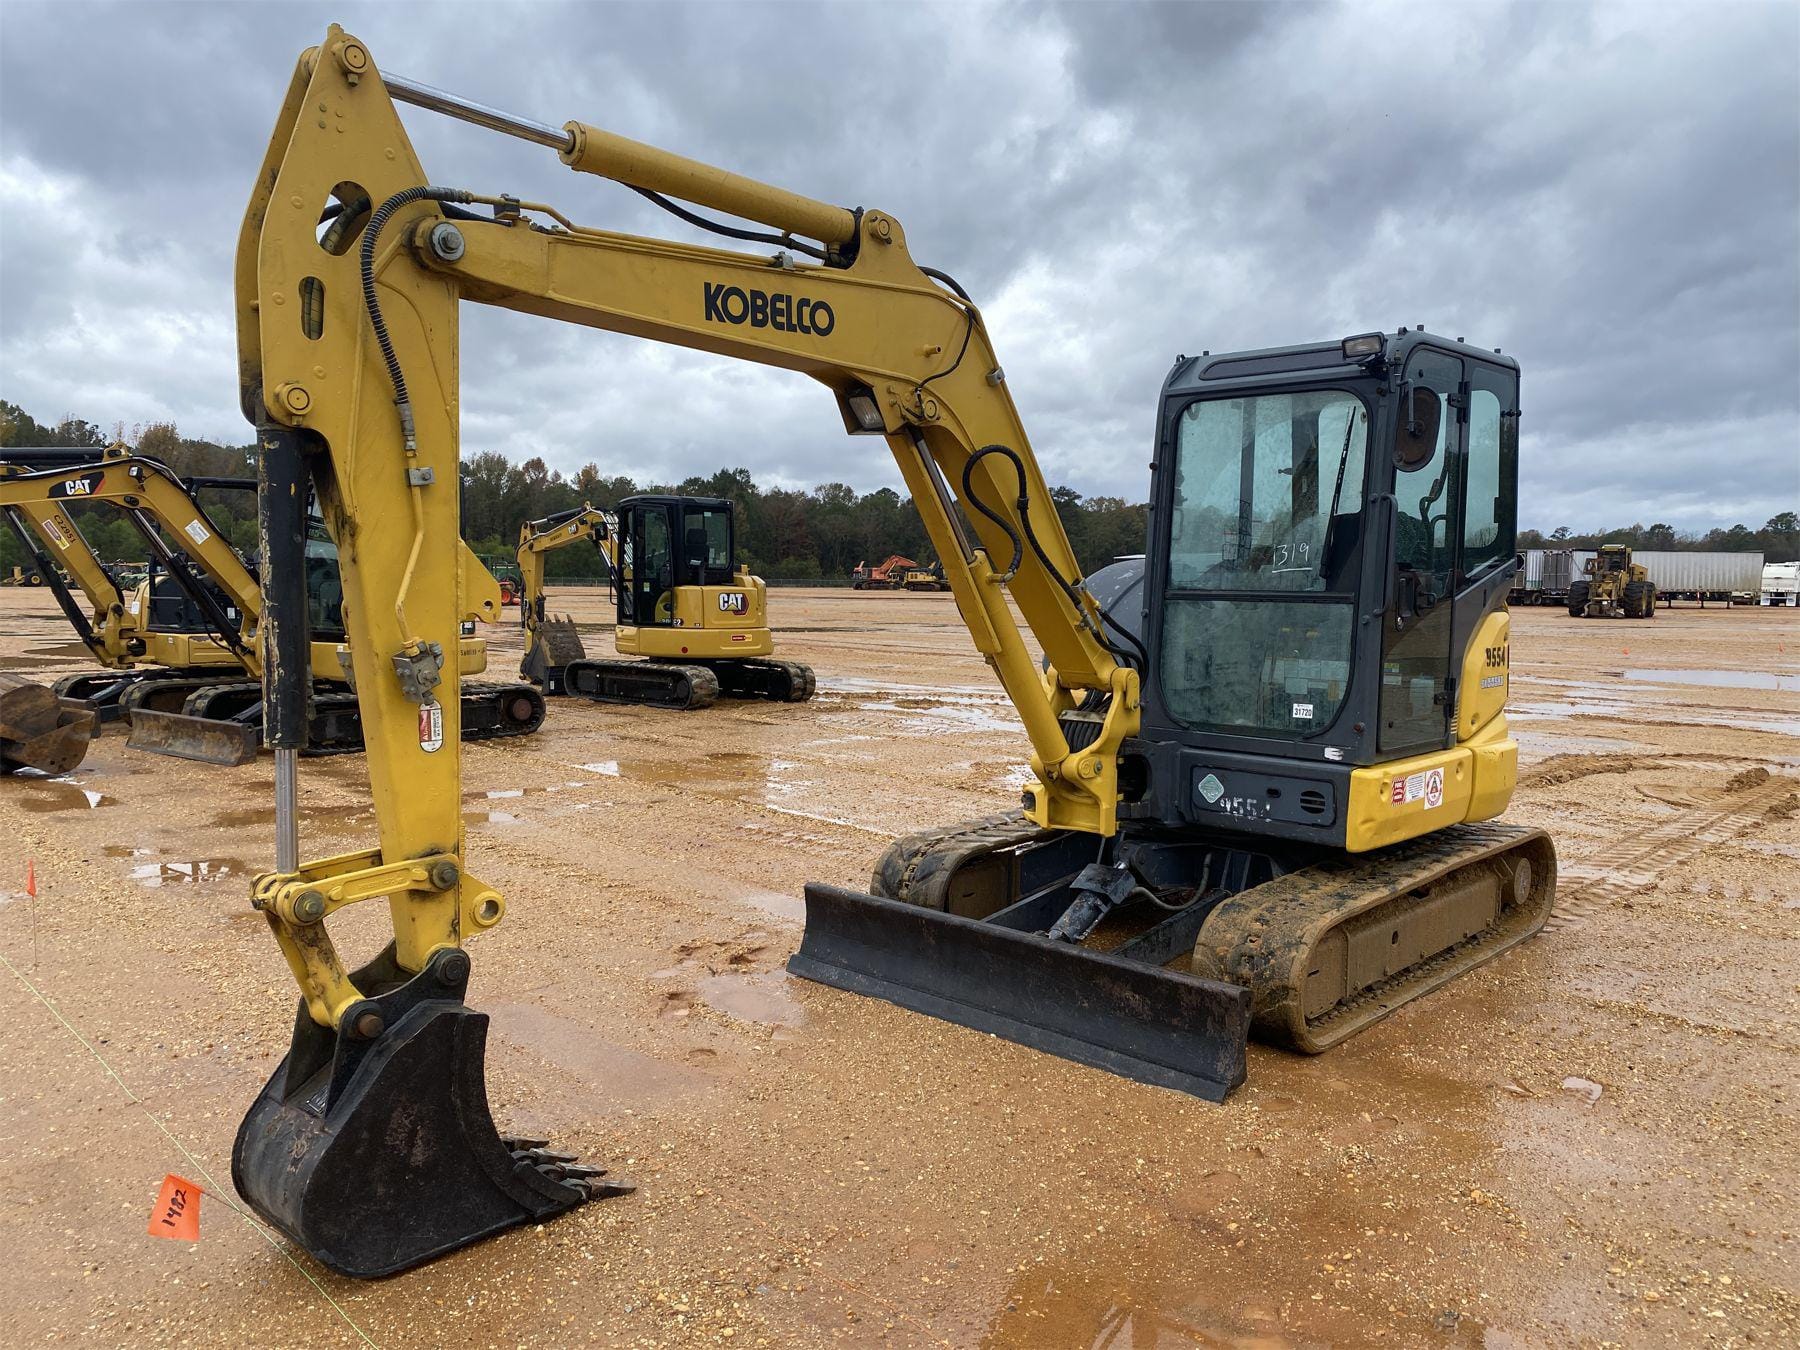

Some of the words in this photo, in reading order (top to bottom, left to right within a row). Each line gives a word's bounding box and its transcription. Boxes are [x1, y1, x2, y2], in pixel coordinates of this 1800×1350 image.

[704, 282, 835, 336] KOBELCO
[65, 480, 90, 495] CAT
[54, 515, 76, 543] C22951
[1273, 543, 1309, 568] 1319
[719, 593, 743, 611] CAT
[1486, 646, 1505, 667] 9554
[161, 1189, 187, 1227] 1482
